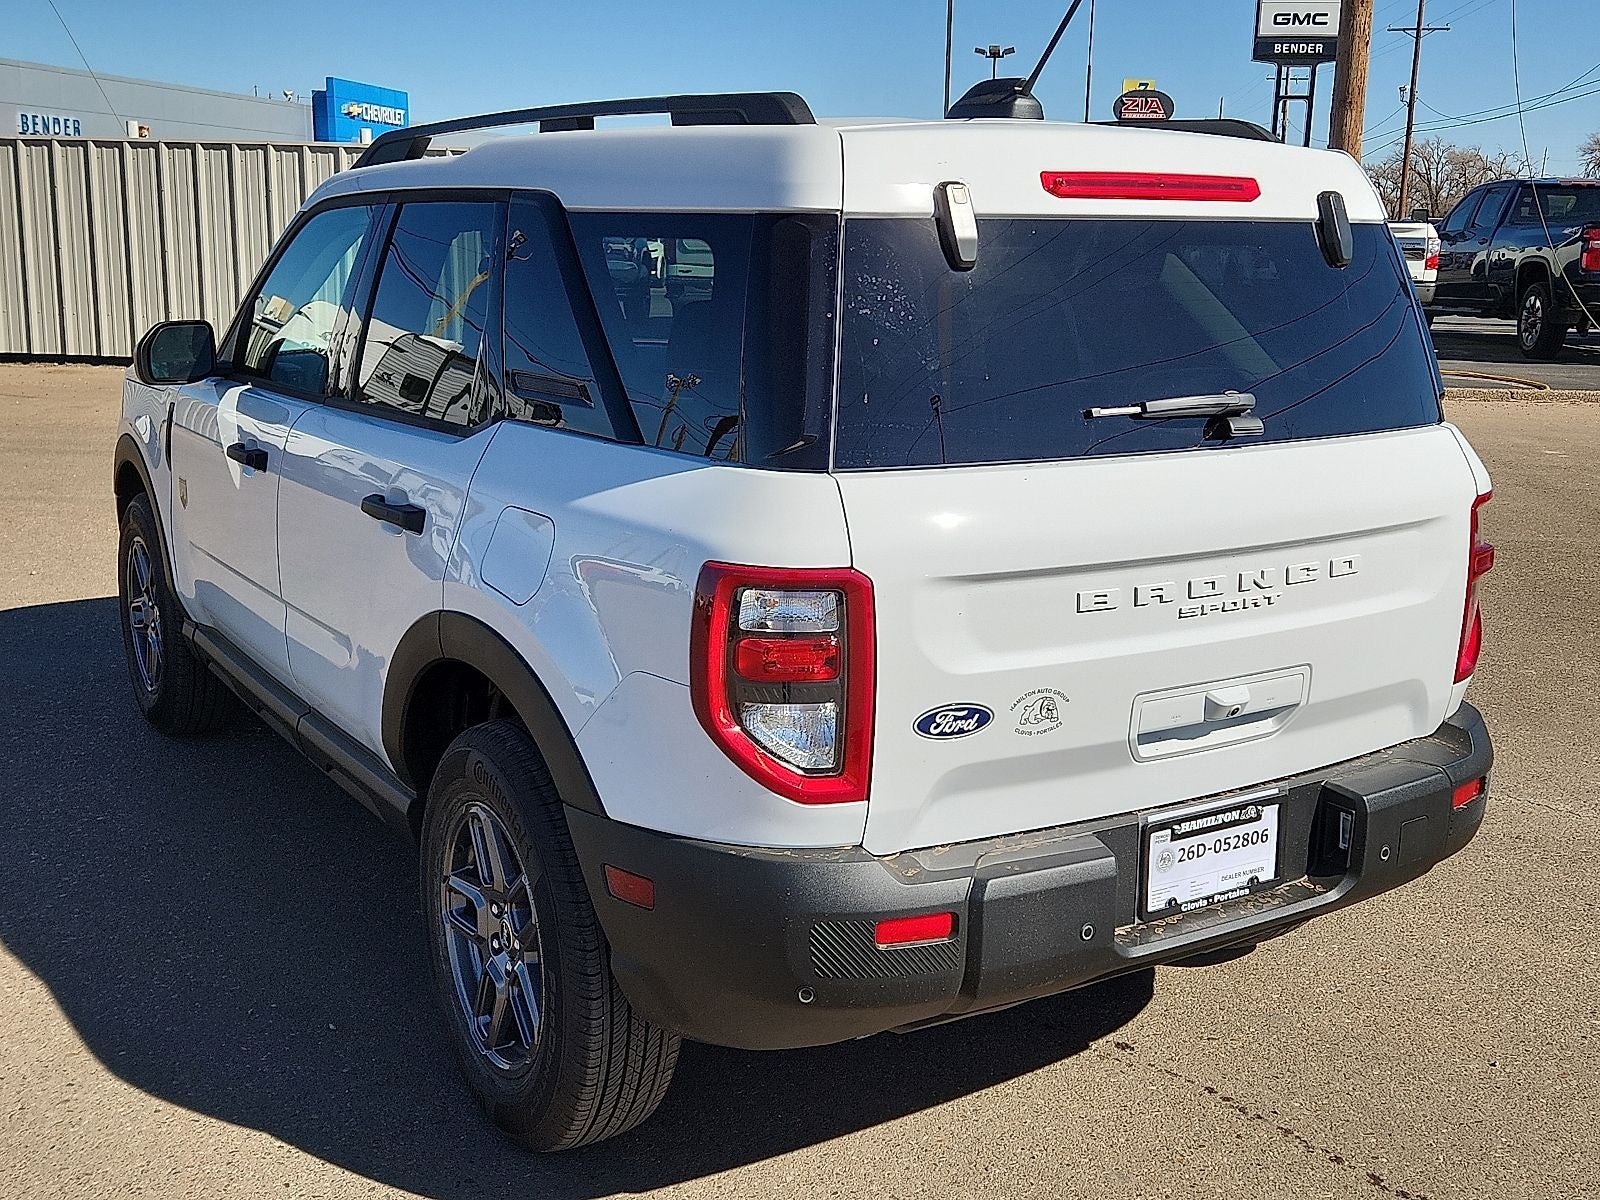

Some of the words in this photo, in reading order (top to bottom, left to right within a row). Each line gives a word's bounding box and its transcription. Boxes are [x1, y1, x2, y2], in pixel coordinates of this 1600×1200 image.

[1272, 12, 1329, 26] GMC
[1273, 43, 1324, 54] BENDER
[362, 103, 406, 125] CHEVROLET
[1121, 97, 1165, 113] ZIA
[20, 113, 81, 136] BENDER
[1075, 554, 1361, 614] BRONCO
[1177, 592, 1282, 620] SPORT
[1009, 690, 1036, 712] HAMILTON
[1053, 689, 1070, 703] GROUP
[929, 709, 981, 735] Ford
[1014, 728, 1033, 736] CLOVIS
[1036, 721, 1063, 735] PORTALES
[1180, 809, 1241, 833] HAMILTON
[1177, 827, 1270, 864] 26D-052806
[1220, 871, 1242, 882] DEALER
[1242, 866, 1265, 876] NUMBER
[1181, 898, 1208, 912] Clovis
[1214, 888, 1250, 903] Portales
